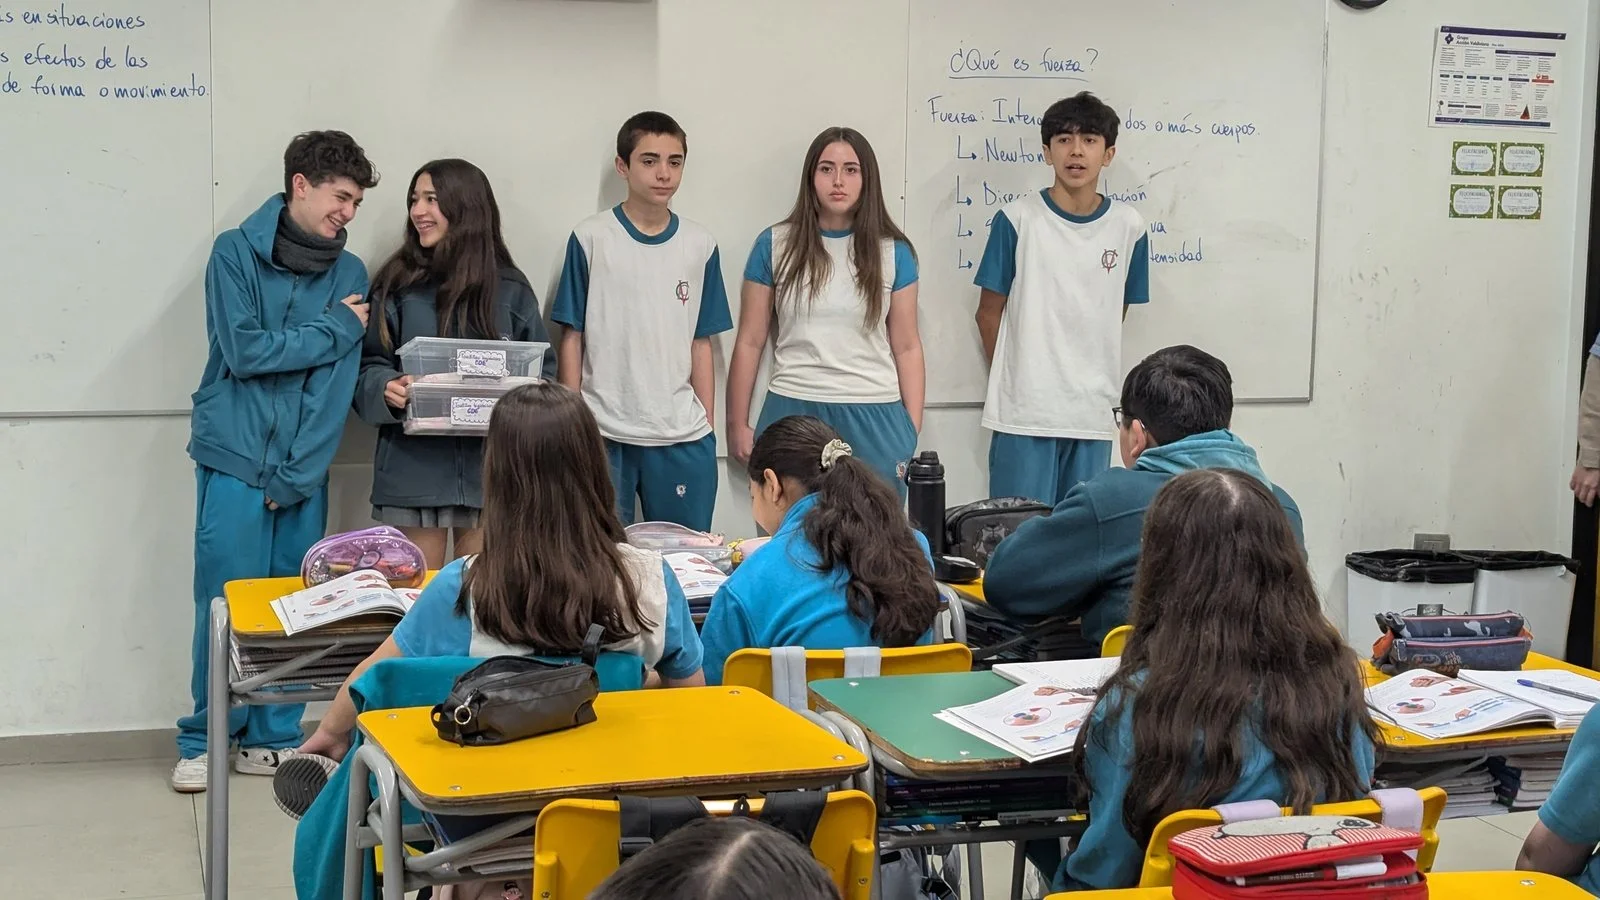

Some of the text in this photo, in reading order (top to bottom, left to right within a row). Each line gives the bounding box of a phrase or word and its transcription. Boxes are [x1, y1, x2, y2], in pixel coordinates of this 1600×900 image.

[47, 3, 145, 29] situaciones
[24, 43, 86, 68] efectos
[95, 46, 117, 70] de
[125, 45, 148, 68] las
[1013, 58, 1030, 71] es
[2, 72, 22, 93] de
[31, 74, 86, 97] forma
[928, 95, 985, 123] Fuerza:
[1125, 108, 1147, 131] dos
[1167, 113, 1202, 134] más
[1211, 121, 1261, 145] cuerpos.
